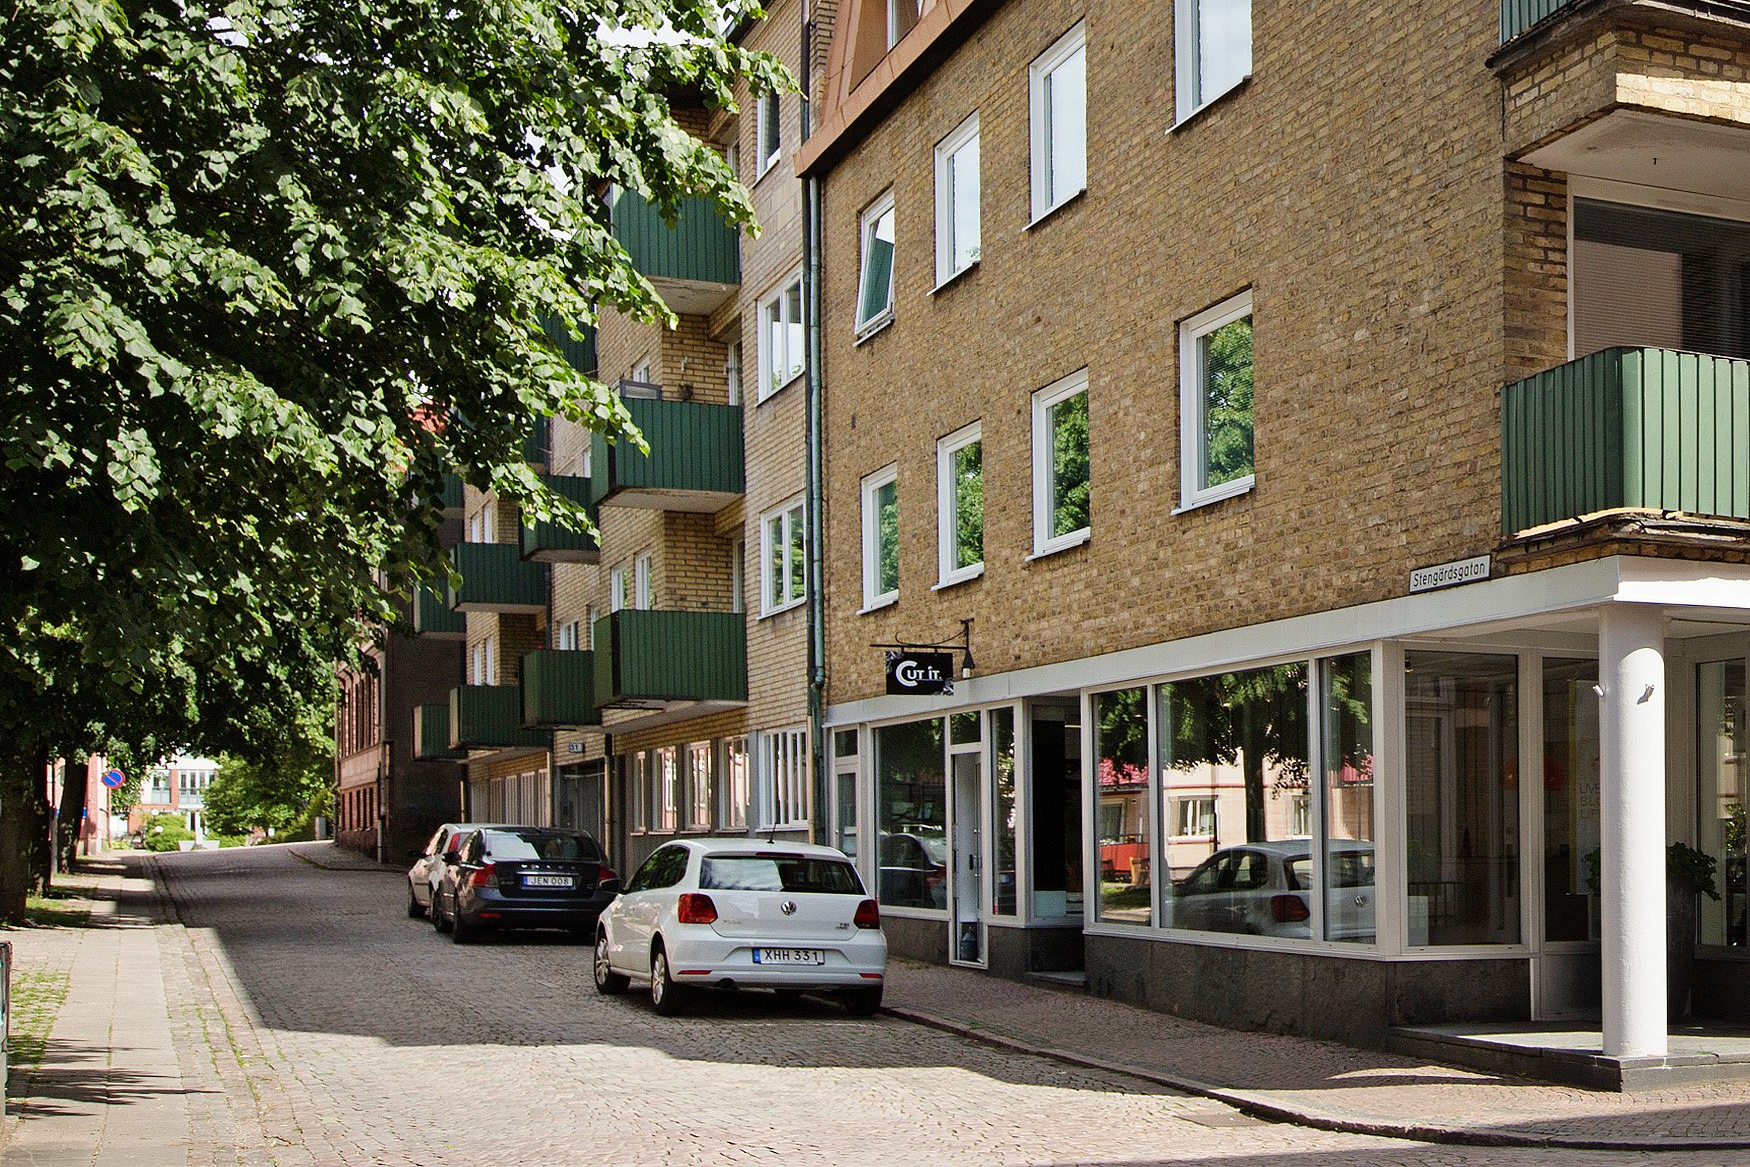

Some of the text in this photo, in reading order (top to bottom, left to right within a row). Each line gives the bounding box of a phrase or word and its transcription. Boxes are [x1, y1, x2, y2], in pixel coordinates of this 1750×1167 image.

[1413, 562, 1485, 587] Stengärdsgatan
[531, 876, 549, 885] JEN
[765, 949, 818, 962] XHH 331
